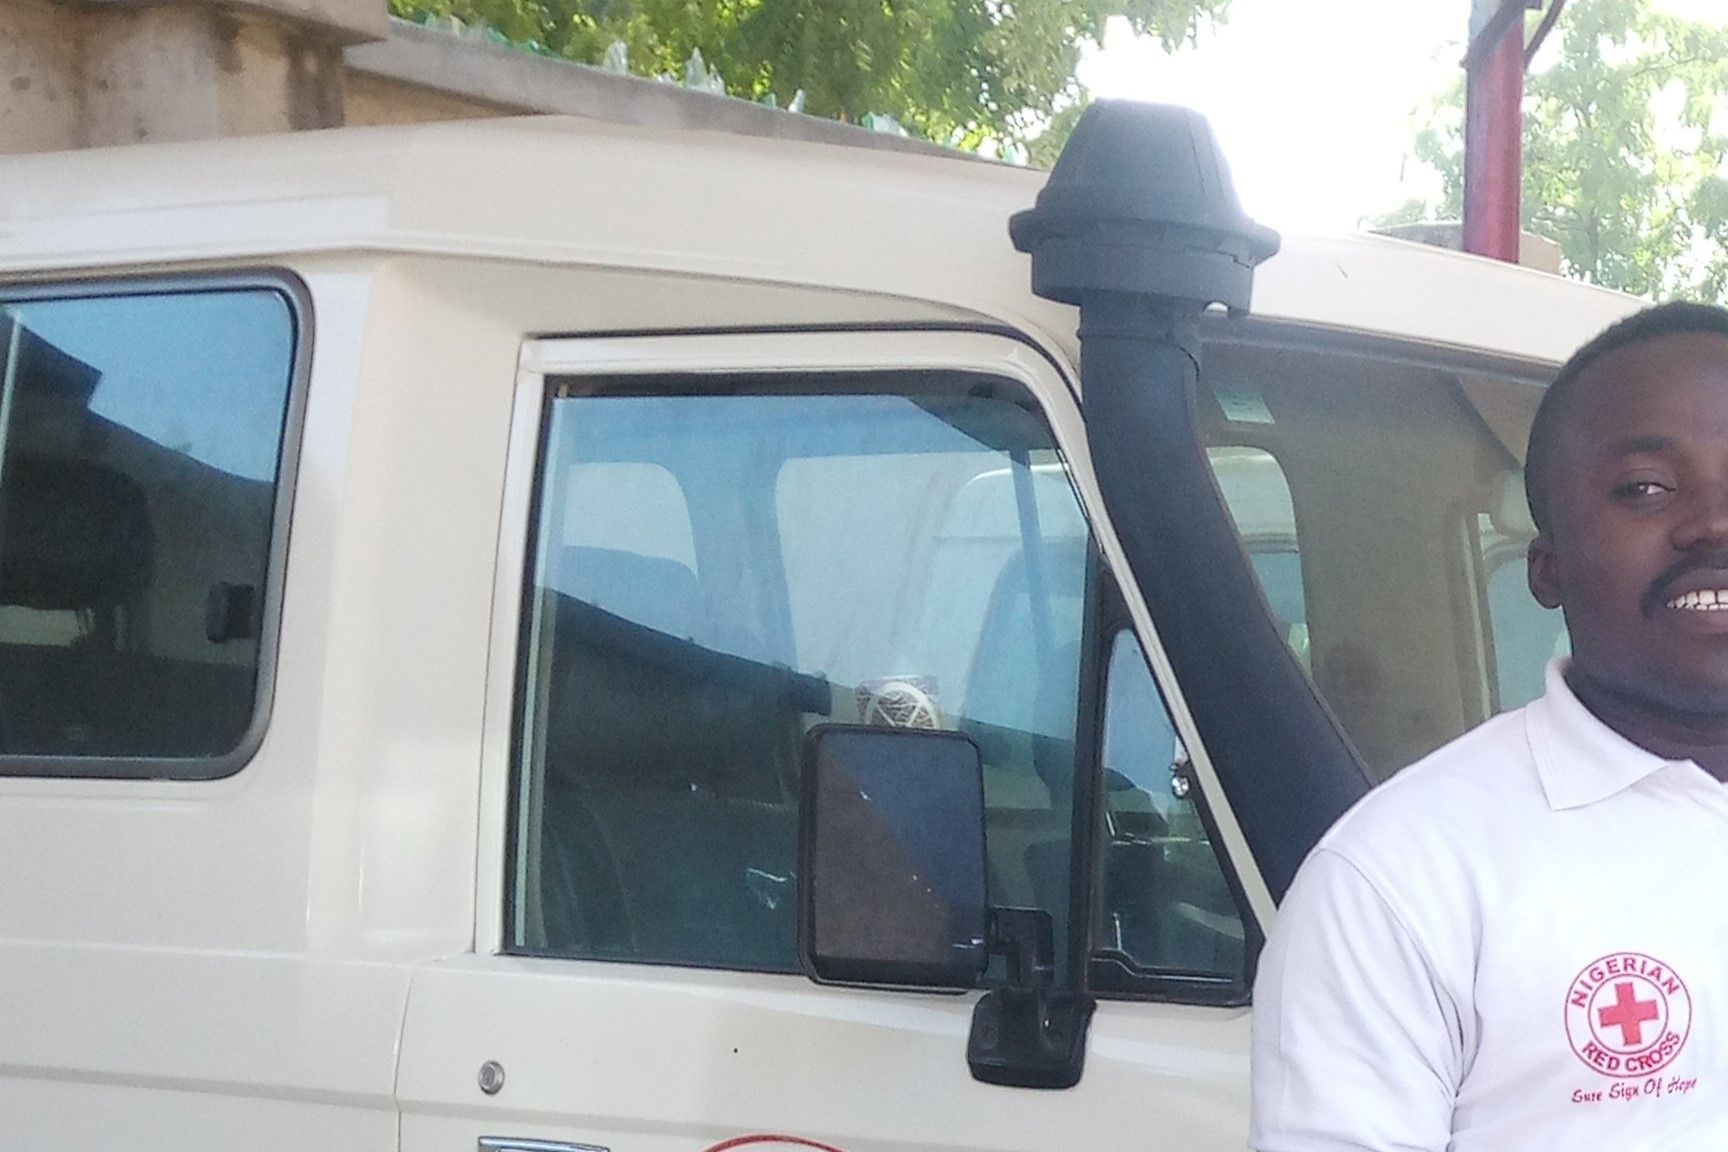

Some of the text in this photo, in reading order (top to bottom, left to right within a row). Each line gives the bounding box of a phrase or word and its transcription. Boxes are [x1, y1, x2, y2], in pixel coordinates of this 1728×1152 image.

[1571, 957, 1680, 1008] NIGERIAN
[1582, 1031, 1681, 1072] RED CROSS
[1572, 1075, 1697, 1103] Sure Sign Of Hope
